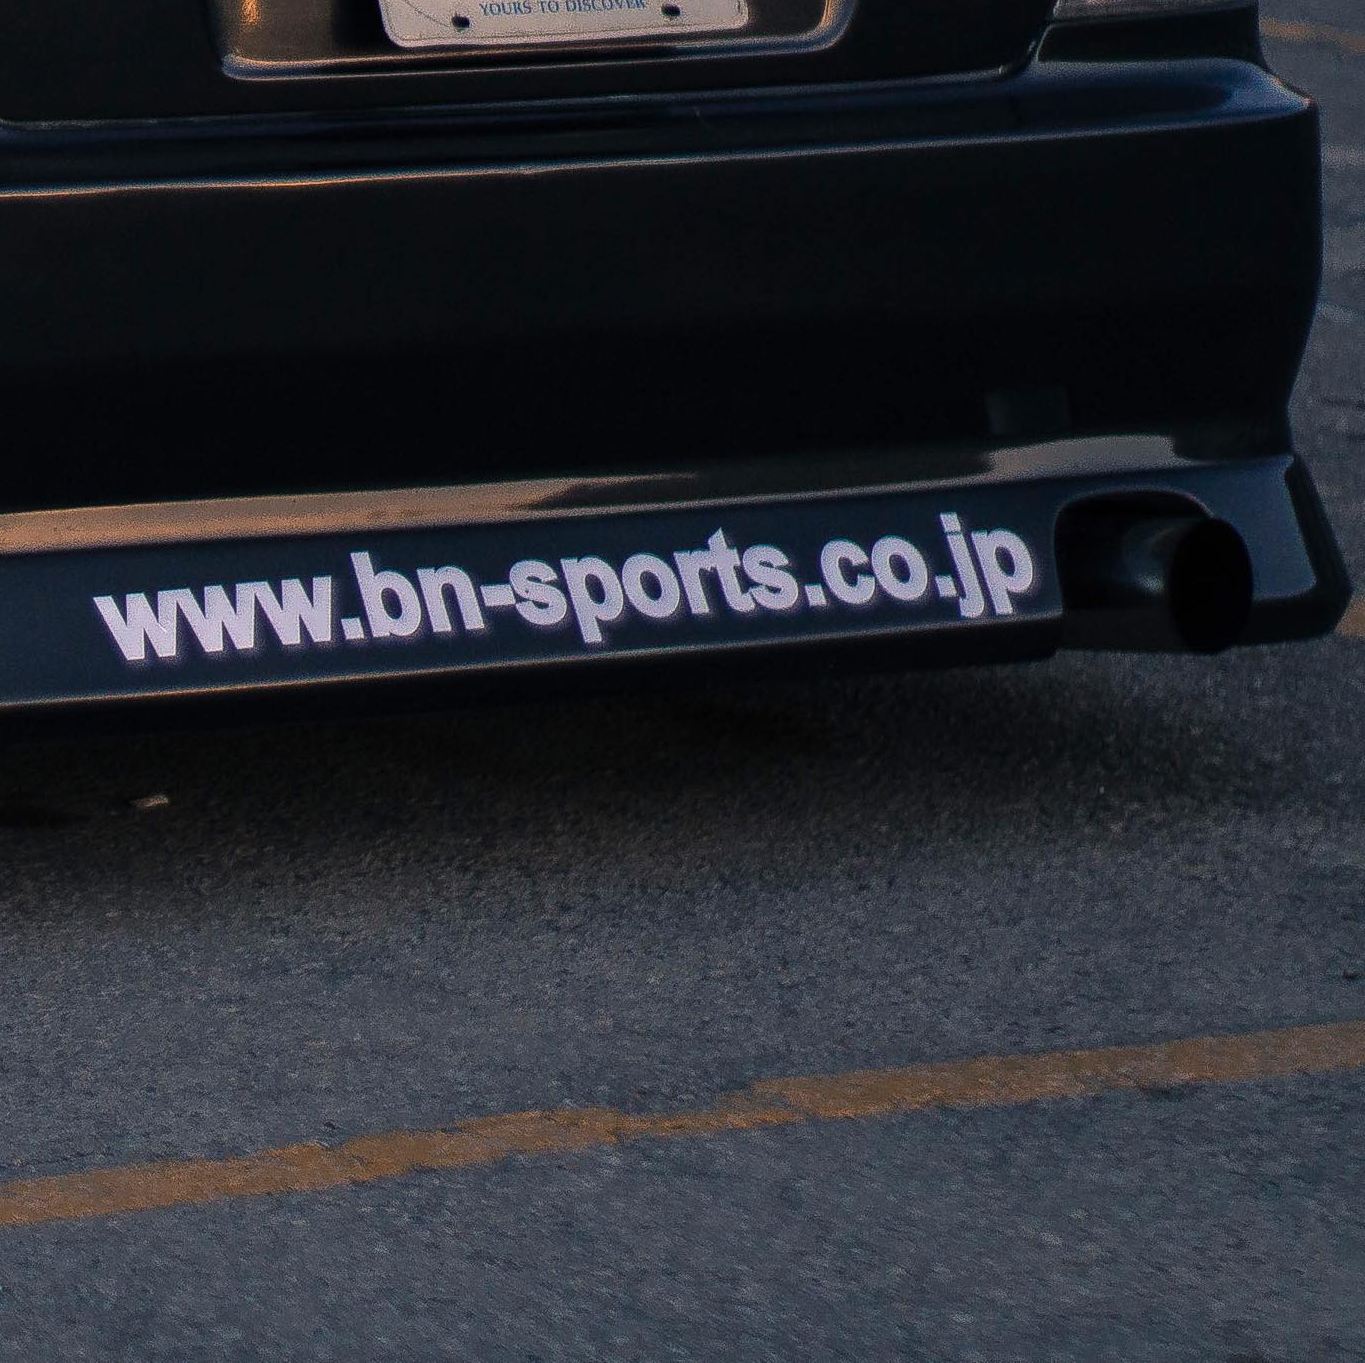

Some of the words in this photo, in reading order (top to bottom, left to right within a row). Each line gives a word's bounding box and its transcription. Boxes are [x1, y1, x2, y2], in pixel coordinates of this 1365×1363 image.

[478, 0, 533, 17] YOURS
[537, 0, 560, 14] TO
[93, 510, 1036, 665] www.bn-sports.co.jp
